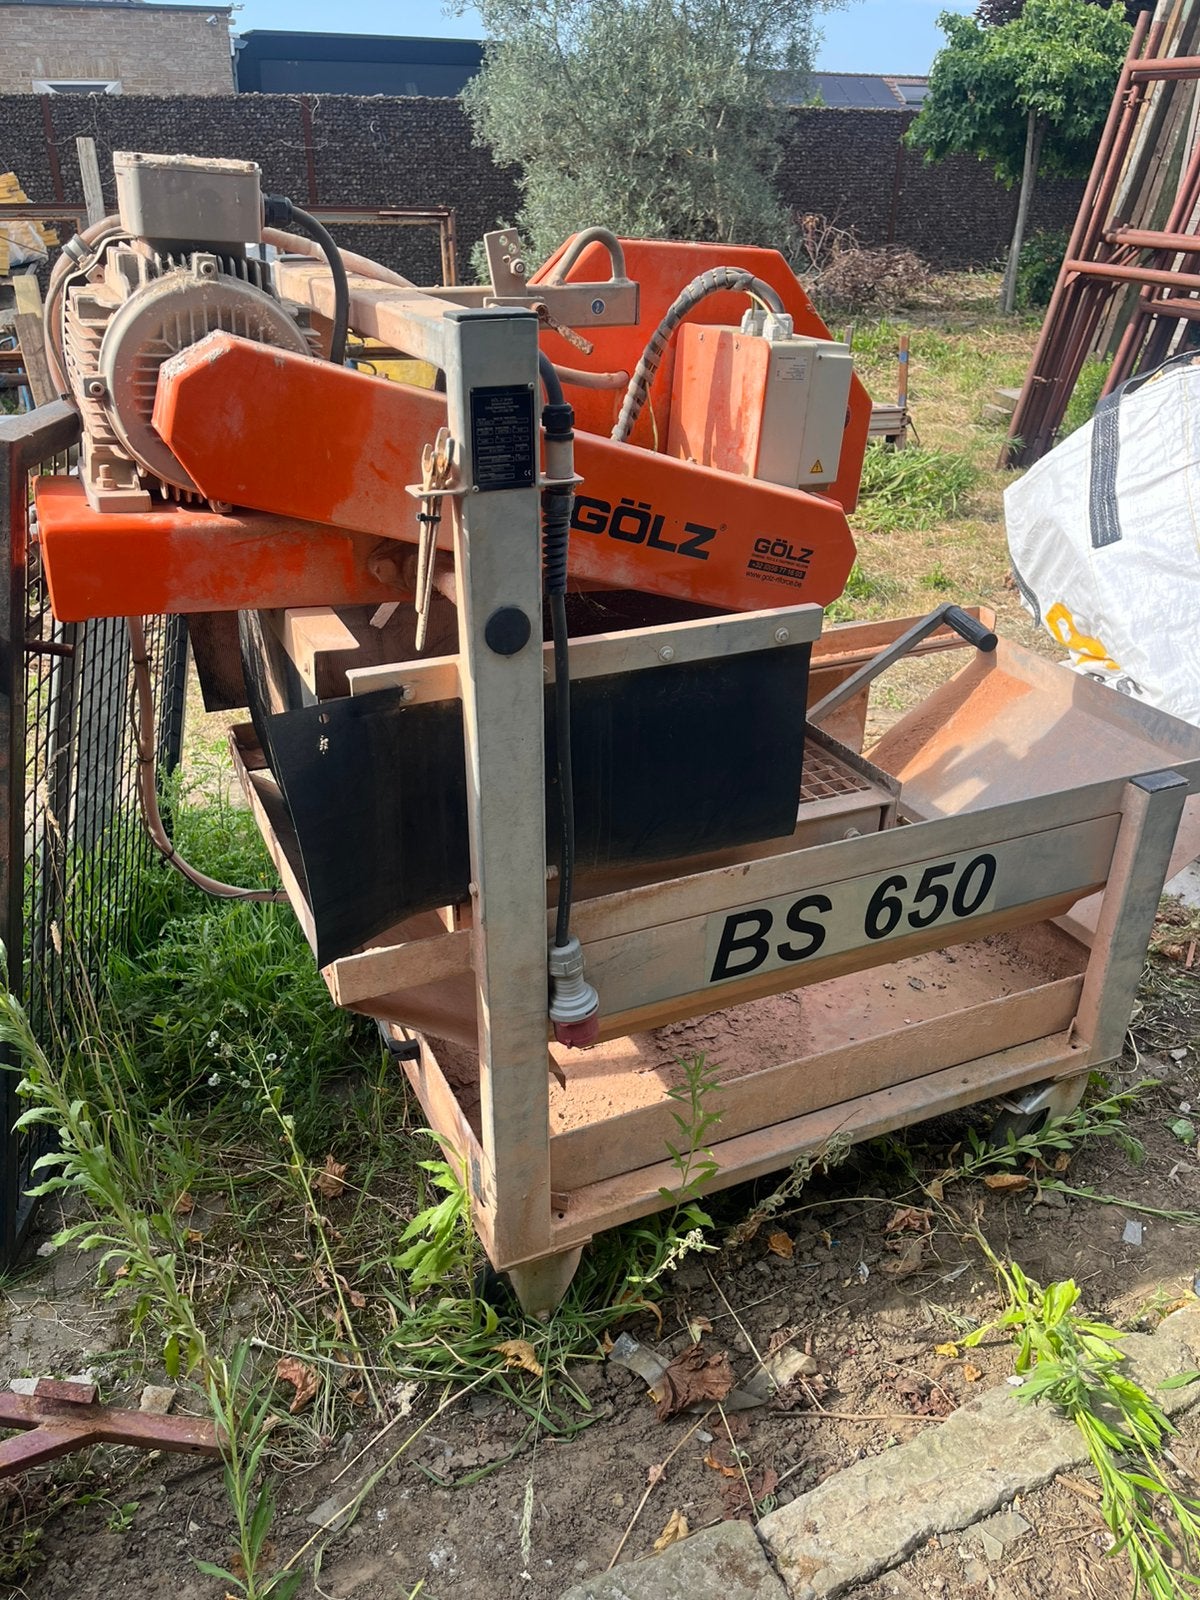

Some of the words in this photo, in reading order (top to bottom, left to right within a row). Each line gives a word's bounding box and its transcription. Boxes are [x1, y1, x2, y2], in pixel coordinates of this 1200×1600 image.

[570, 495, 717, 560] GÖLZ
[754, 537, 814, 564] GÖLZ
[710, 894, 832, 983] BS
[864, 853, 997, 940] 650
